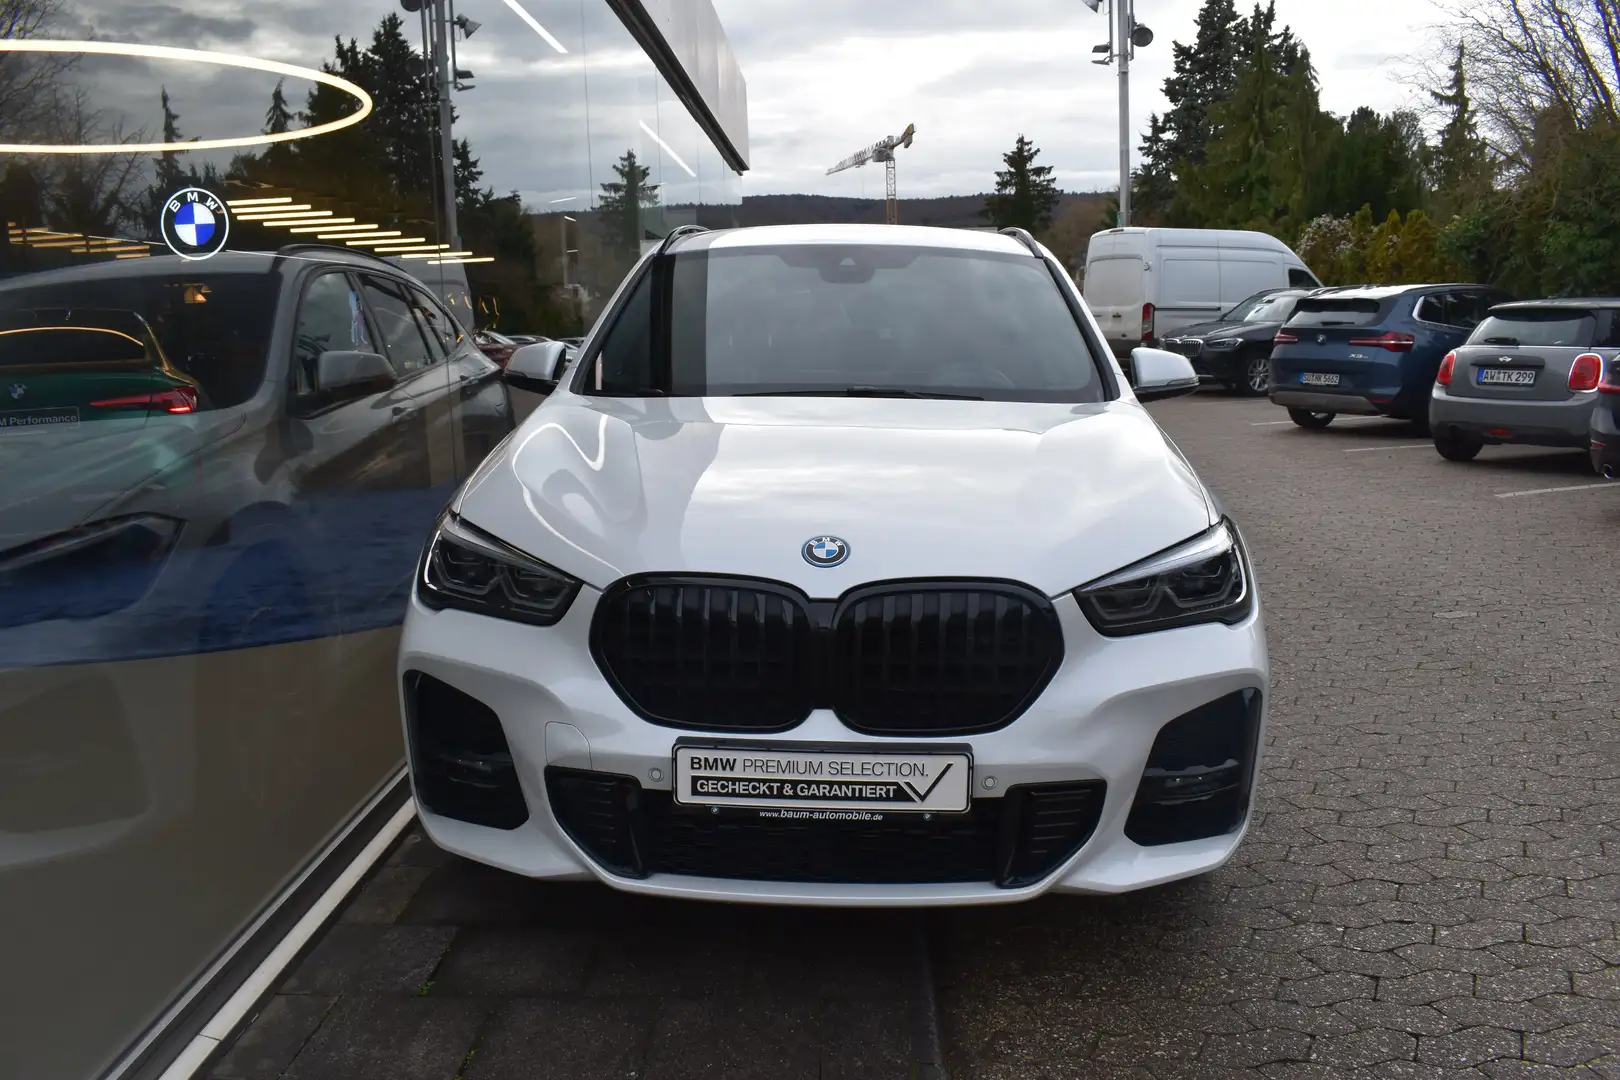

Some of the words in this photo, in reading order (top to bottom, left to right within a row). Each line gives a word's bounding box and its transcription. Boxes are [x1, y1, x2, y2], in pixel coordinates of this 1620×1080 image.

[169, 192, 218, 213] BMW
[1483, 371, 1496, 381] AW
[1502, 371, 1513, 382] TK
[1515, 372, 1534, 383] 299
[9, 415, 77, 426] Performance
[810, 537, 843, 546] BMW
[690, 756, 737, 772] BMW
[743, 758, 823, 775] PREMIUM
[828, 760, 929, 777] SELECTION.
[696, 779, 781, 795] GECHECKT
[783, 783, 794, 796] &
[796, 783, 898, 798] GARANTIERT
[759, 809, 883, 821] www.baum-automobile.de
